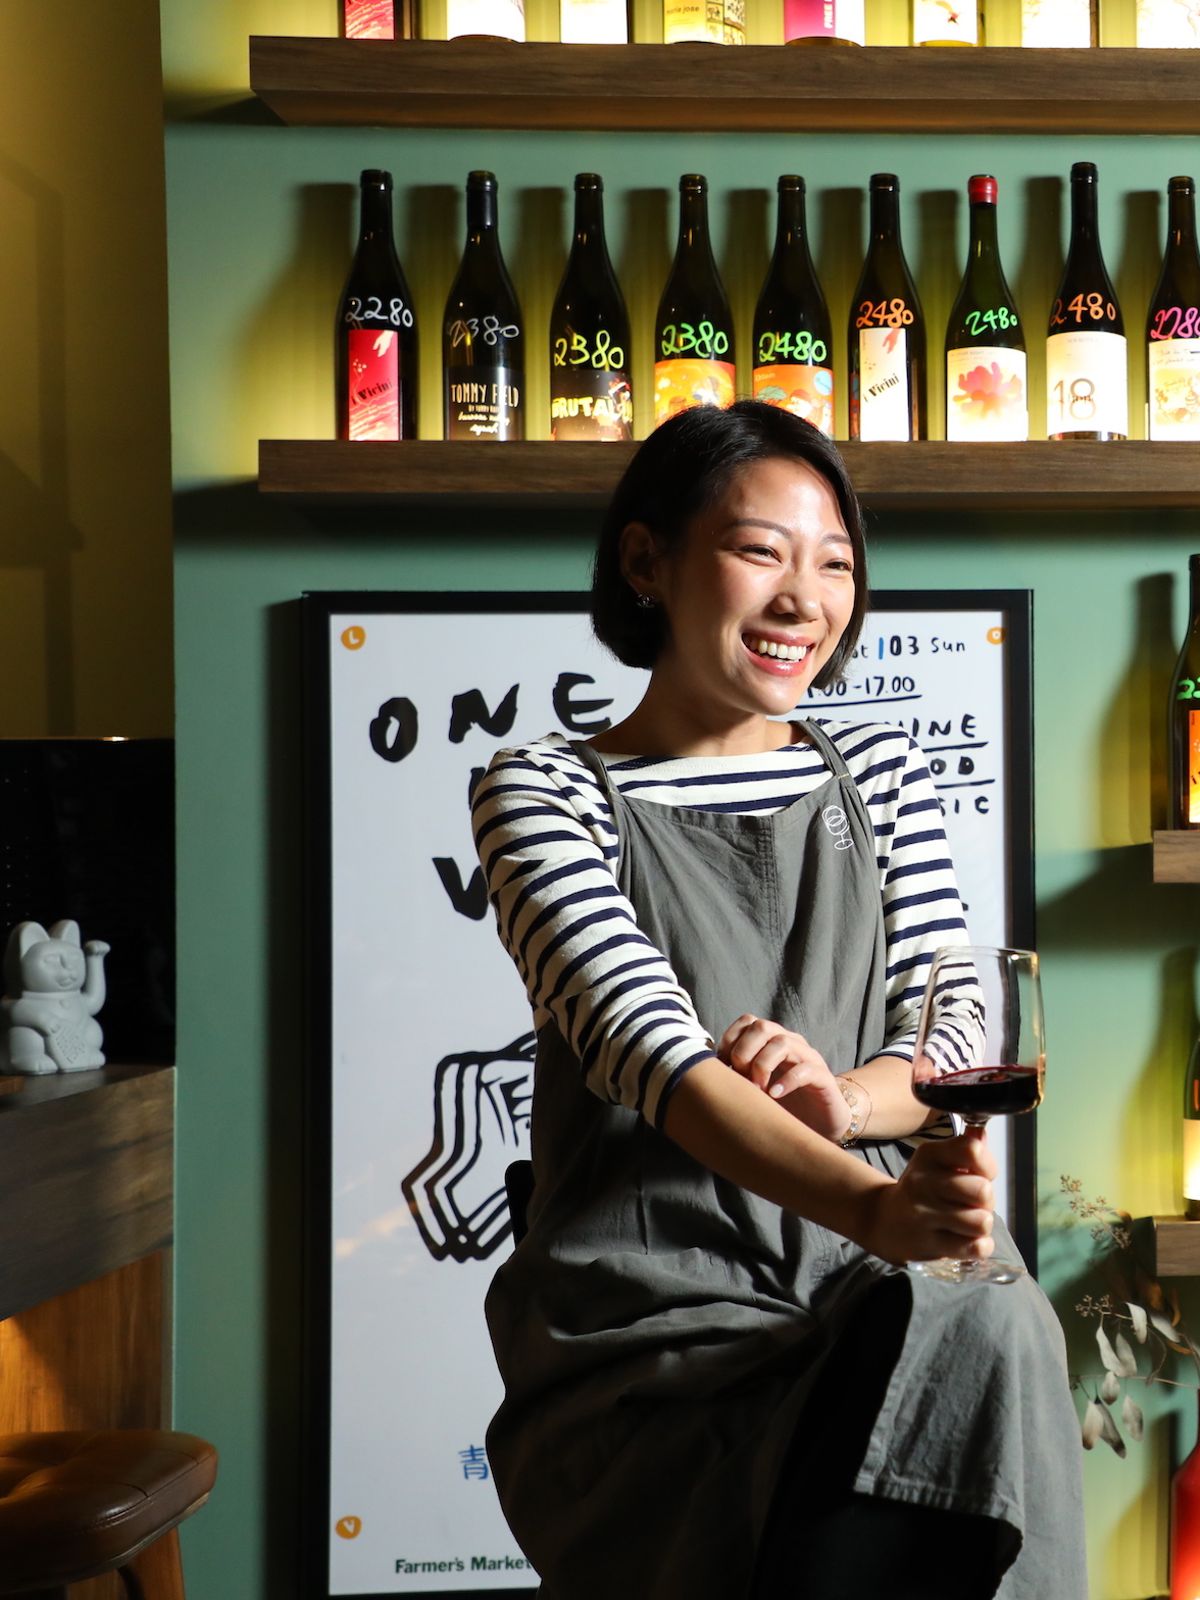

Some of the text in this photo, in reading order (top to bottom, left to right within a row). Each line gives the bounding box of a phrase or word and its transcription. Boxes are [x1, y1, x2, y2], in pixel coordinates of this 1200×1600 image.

[345, 297, 413, 328] 2280
[856, 298, 914, 329] 2480
[965, 307, 1018, 336] 2480
[1051, 292, 1116, 326] 2480
[450, 316, 519, 346] 2380
[661, 321, 729, 358] 2380
[759, 331, 827, 362] 2480
[554, 330, 624, 368] 2380
[451, 383, 519, 408] TOMMY FELD
[890, 635, 919, 656] 03
[931, 637, 966, 653] Sun
[370, 672, 614, 763] ONE
[912, 714, 976, 738] INE
[930, 756, 974, 775] OD
[458, 1445, 490, 1480] 青
[395, 1557, 464, 1574] Farmer's
